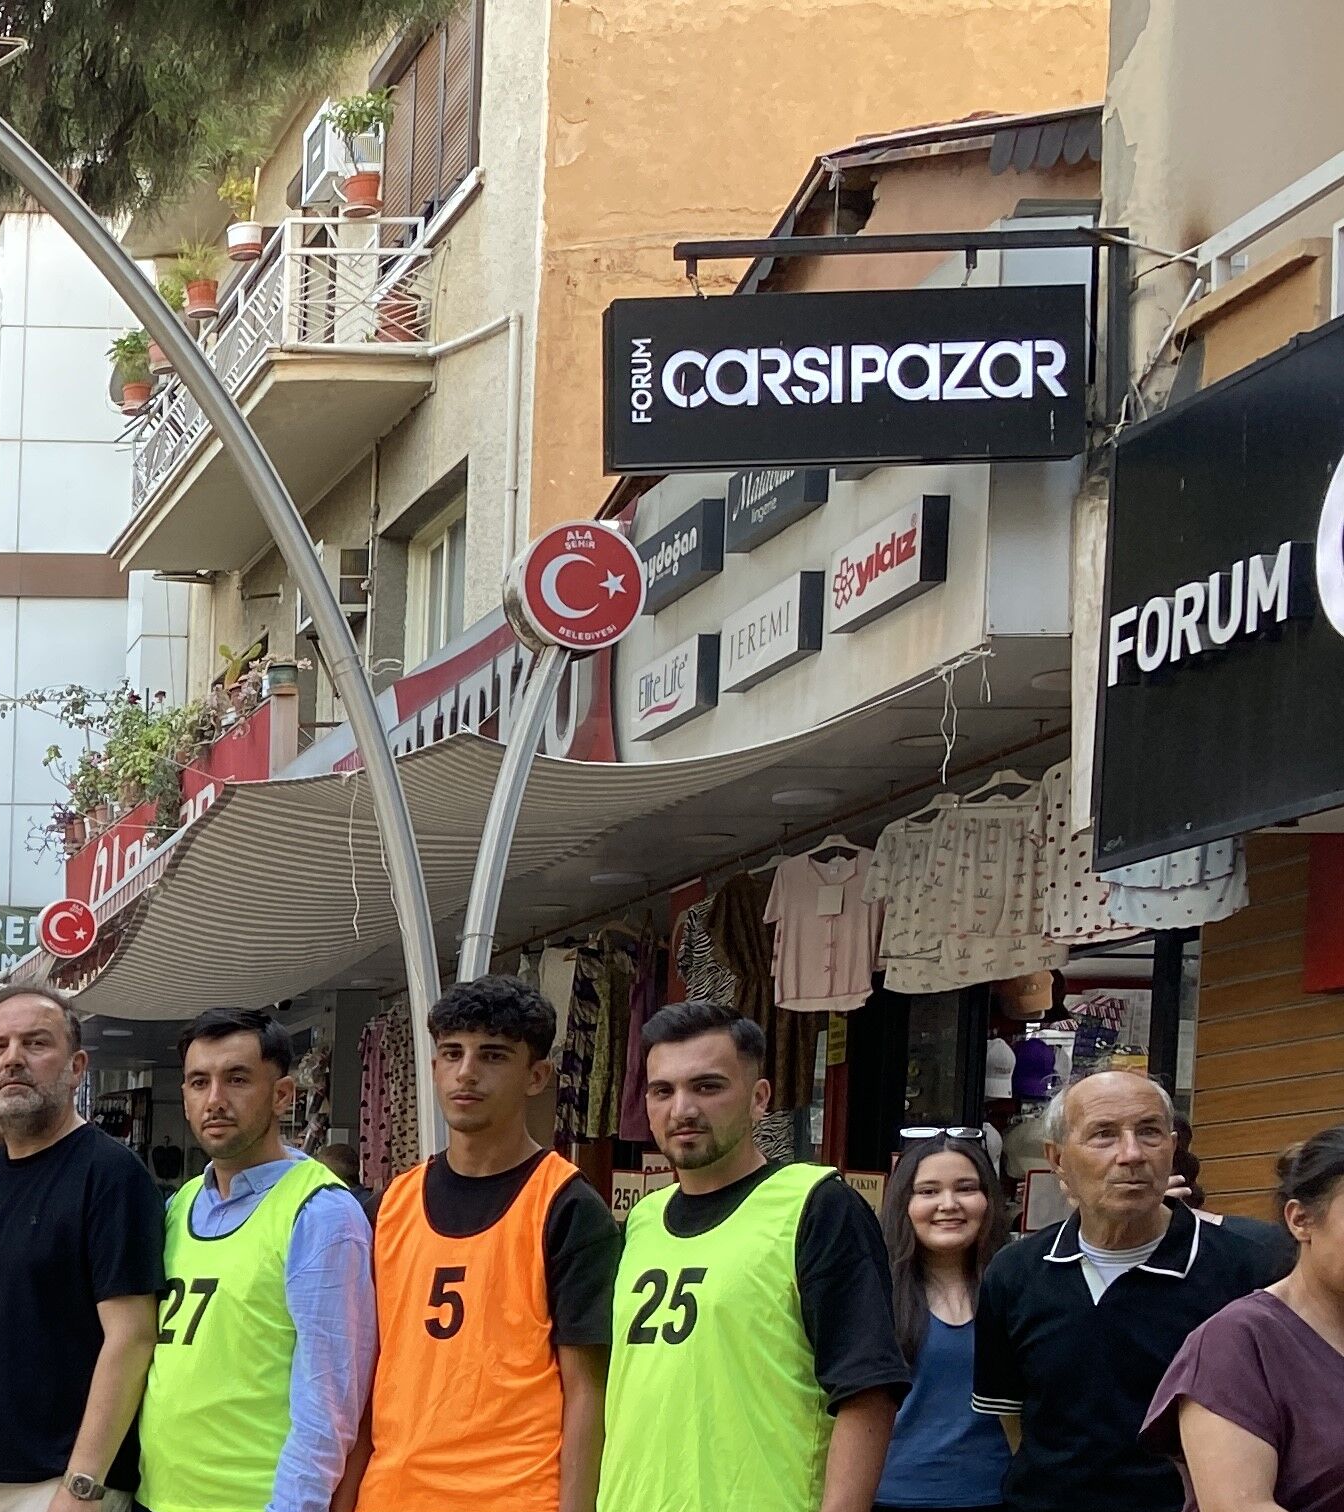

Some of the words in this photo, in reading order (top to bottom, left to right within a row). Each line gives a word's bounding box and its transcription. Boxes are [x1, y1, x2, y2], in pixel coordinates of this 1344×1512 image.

[631, 337, 653, 424] FORUM
[566, 530, 593, 541] ALA
[728, 600, 791, 672] JEREMI
[1107, 540, 1292, 688] FORUM
[613, 1187, 640, 1211] 250
[155, 1277, 220, 1346] 27
[423, 1265, 467, 1340] 5
[627, 1267, 708, 1345] 25
